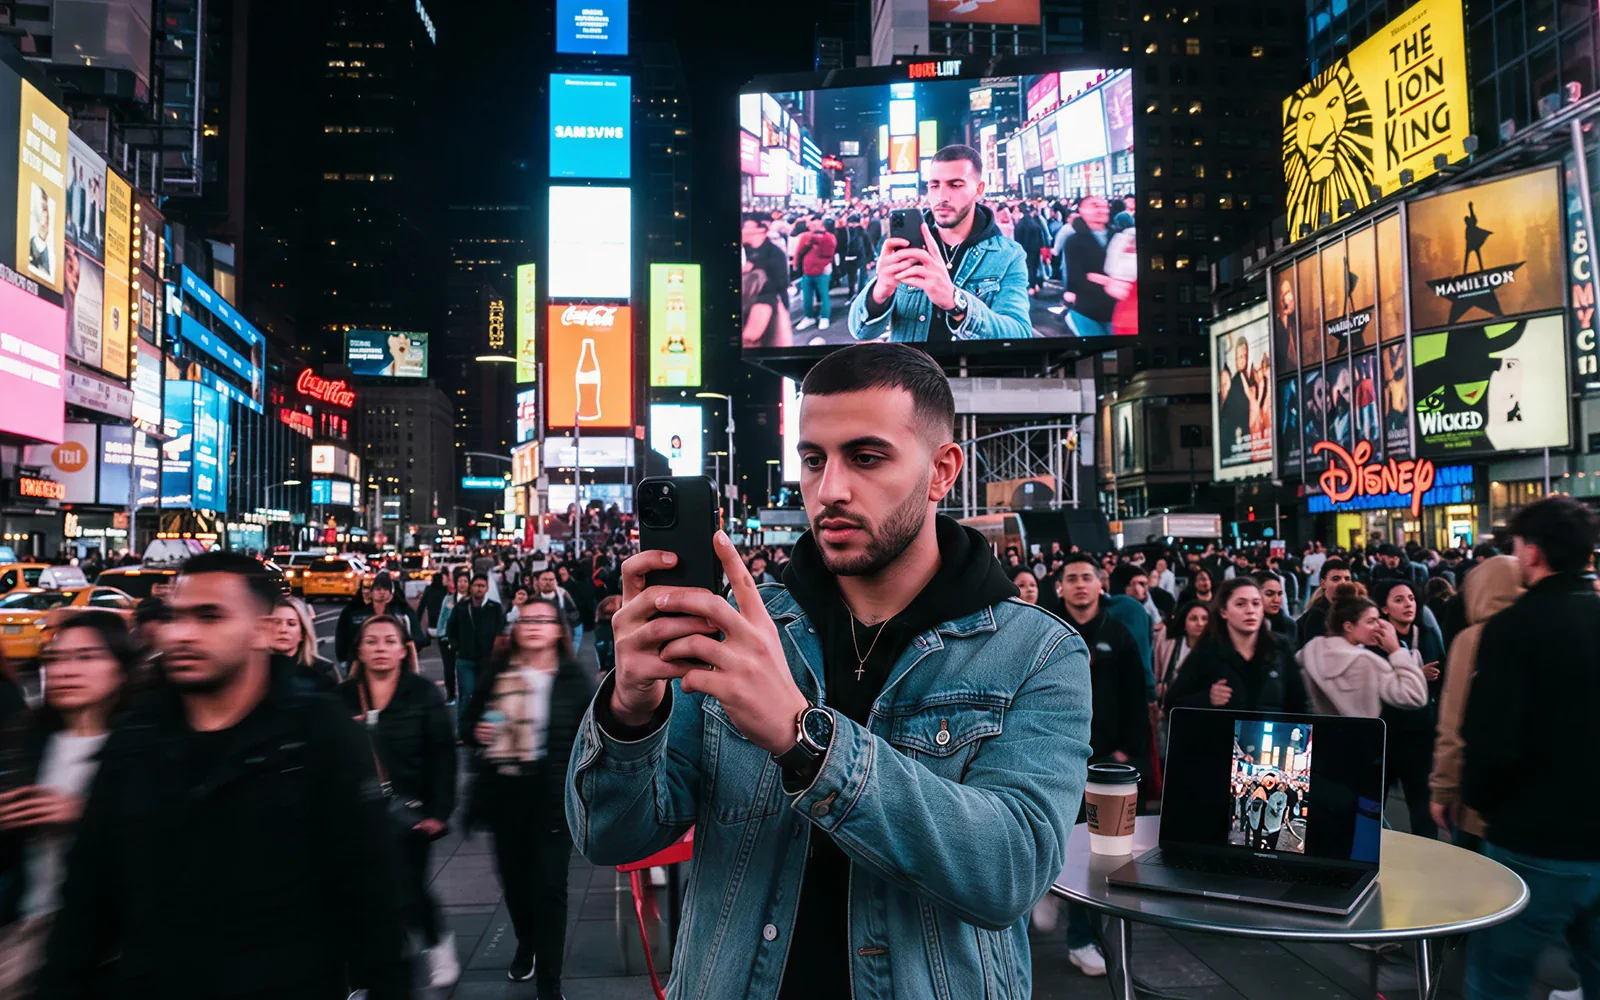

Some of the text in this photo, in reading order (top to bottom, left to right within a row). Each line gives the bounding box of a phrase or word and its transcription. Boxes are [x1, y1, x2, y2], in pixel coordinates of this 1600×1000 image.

[1389, 22, 1433, 72] THE
[1385, 56, 1444, 119] LION
[1385, 101, 1451, 172] KING
